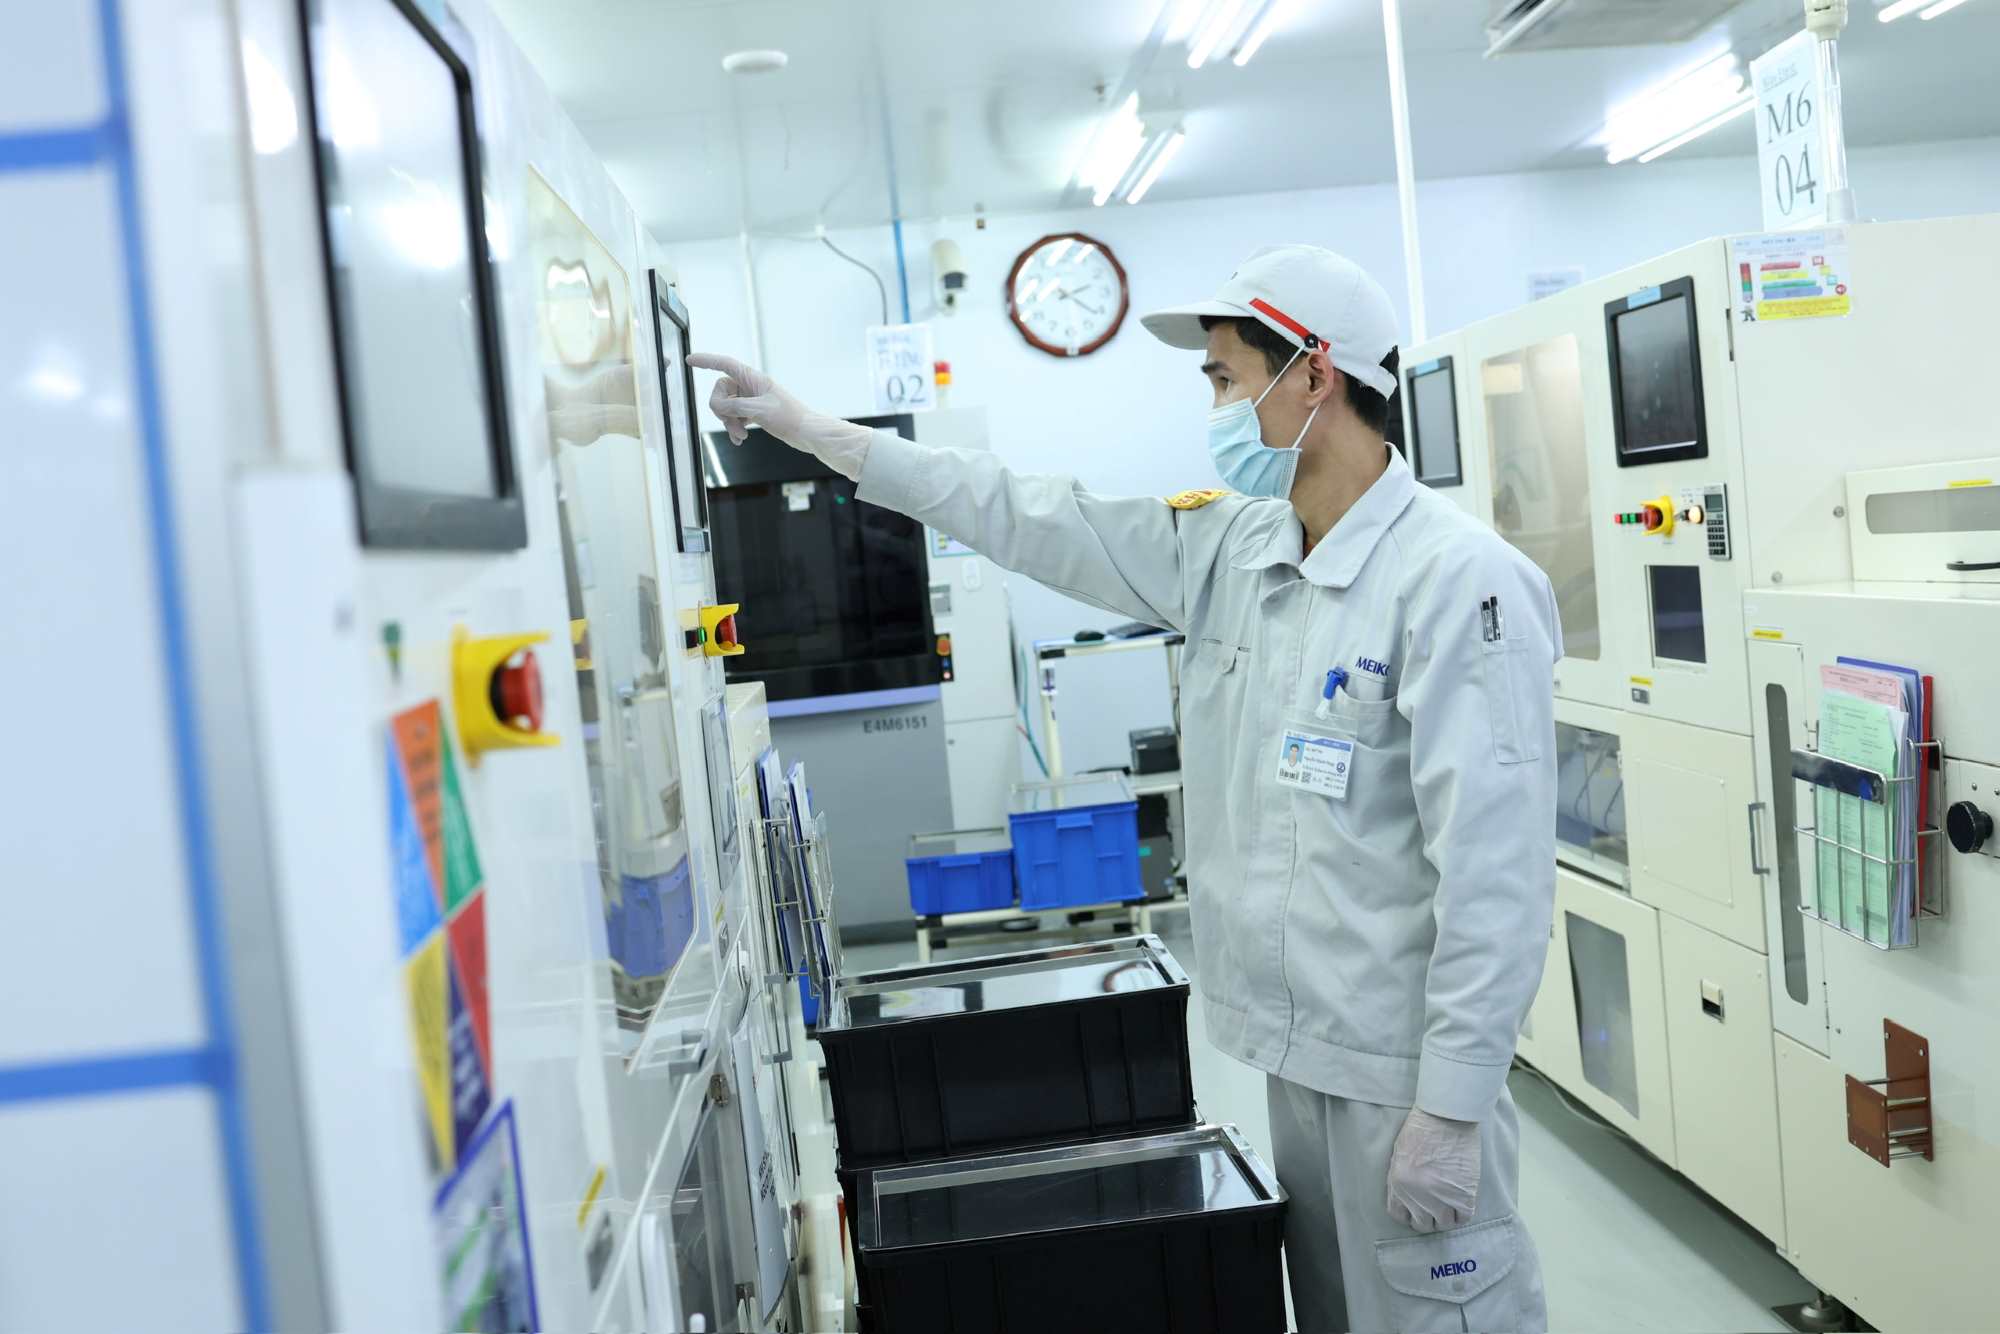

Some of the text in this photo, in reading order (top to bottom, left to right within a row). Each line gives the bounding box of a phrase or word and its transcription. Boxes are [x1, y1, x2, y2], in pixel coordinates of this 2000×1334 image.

[1766, 80, 1812, 144] M6
[1774, 143, 1817, 217] 04
[887, 374, 926, 404] 02
[863, 715, 928, 734] E4M6151
[1430, 1259, 1477, 1281] MEIKO
